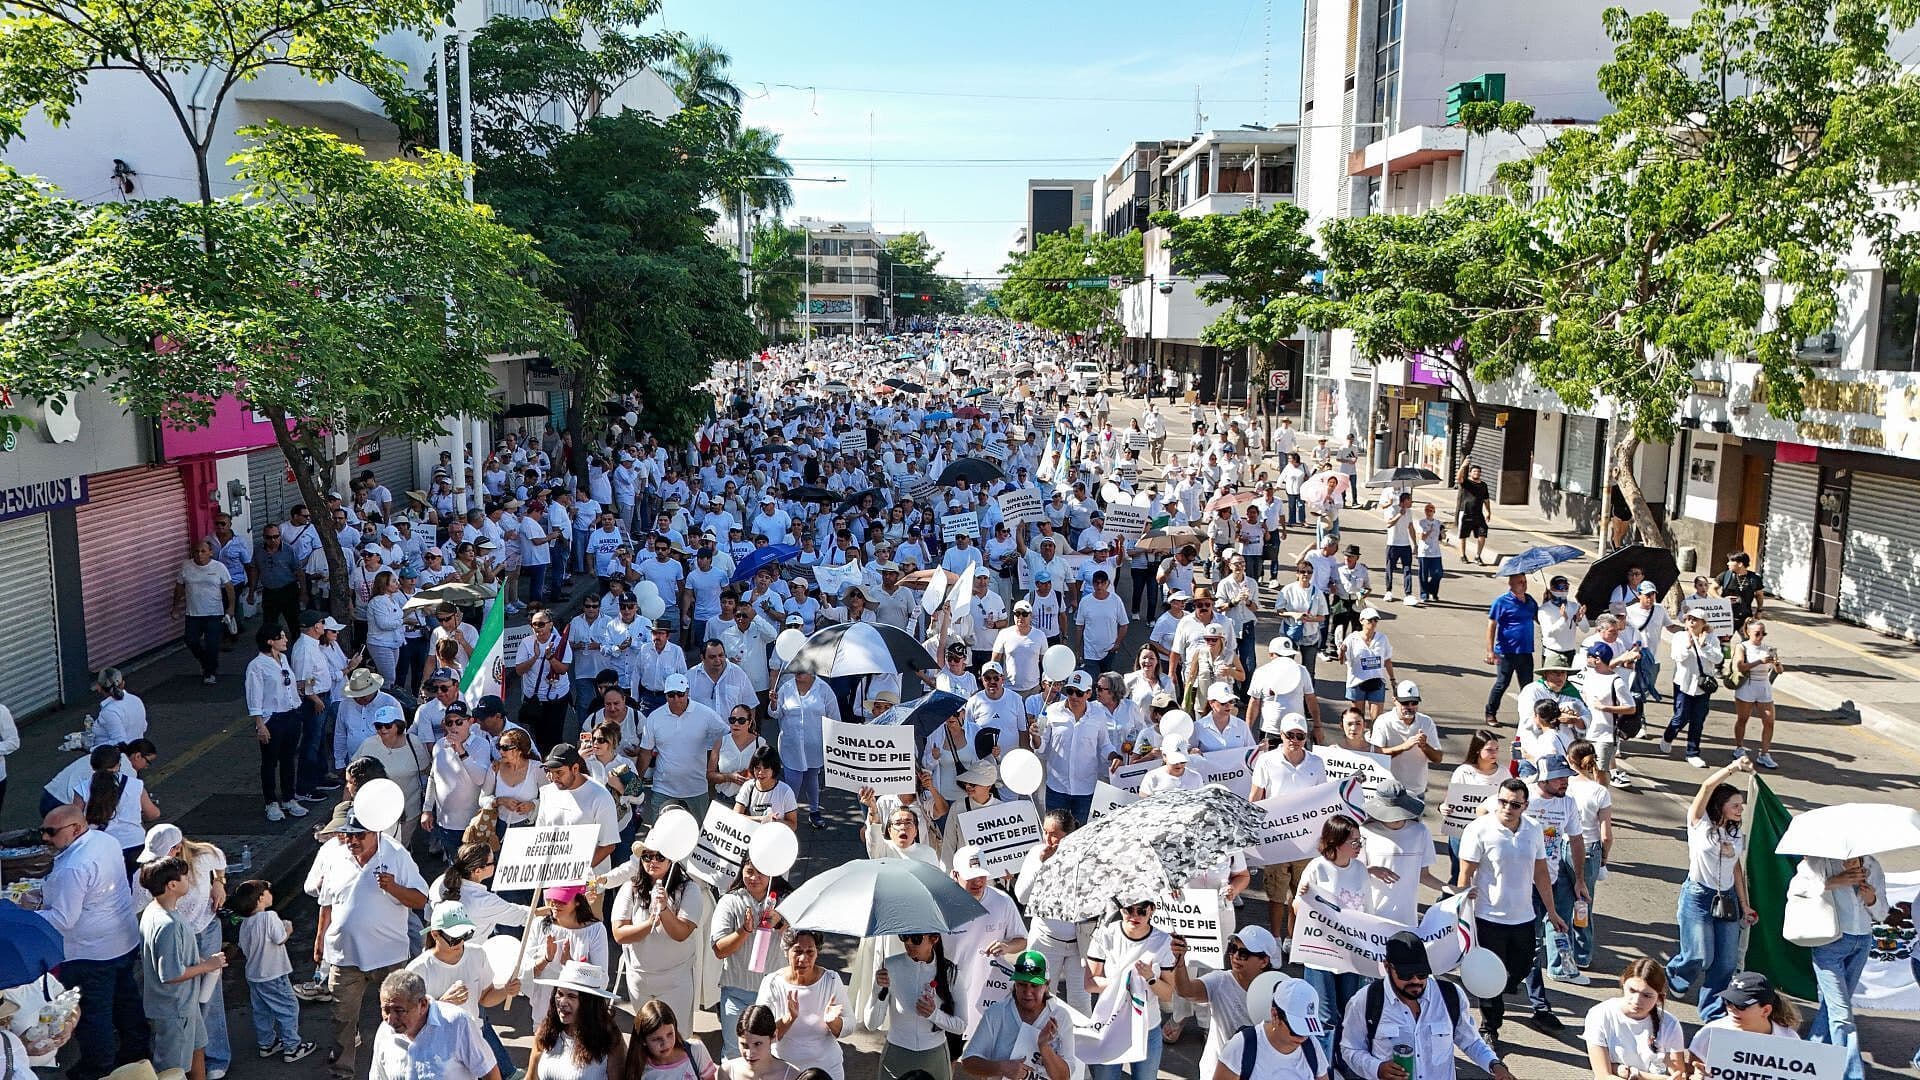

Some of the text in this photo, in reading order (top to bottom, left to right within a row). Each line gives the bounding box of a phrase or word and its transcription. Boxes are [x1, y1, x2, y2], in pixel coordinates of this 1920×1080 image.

[358, 440, 380, 457] HUELGA
[1001, 502, 1021, 513] PONTE
[1006, 494, 1034, 505] SINALOA
[948, 517, 971, 525] SINALOA
[1113, 510, 1140, 518] SINALOA
[837, 735, 896, 749] SINALOA
[825, 745, 911, 762] PONTE DE PIE
[1327, 758, 1375, 772] SINALOA
[826, 767, 839, 775] NO
[839, 770, 856, 781] MÁS
[856, 775, 869, 783] DE
[883, 775, 913, 783] MISMO
[1207, 769, 1244, 783] MIEDO
[1260, 803, 1343, 830] CALLES NO SON
[1448, 804, 1477, 814] PONT
[977, 814, 1024, 832] SINALOA
[535, 830, 570, 846] ¡SINALOA
[700, 829, 733, 852] PONTE
[715, 820, 751, 845] SINALO
[968, 824, 1038, 846] PONTE DE PIE
[1264, 827, 1312, 844] BATALLA.
[525, 844, 573, 857] REFLEXIONA!
[986, 851, 1022, 866] MÁS DE LO
[519, 863, 536, 883] LOS
[536, 861, 572, 881] MISMOS
[691, 852, 737, 878] NO MÁS DE LO
[1156, 901, 1201, 915] SINALOA
[1153, 915, 1217, 930] ONTE DE PIE
[1308, 910, 1367, 941] CULIACÁN
[1193, 945, 1220, 953] MISMO
[1303, 926, 1323, 938] NO
[1326, 934, 1387, 963] SOBREVIV
[986, 979, 1008, 990] NOS
[1732, 1050, 1817, 1076] SINALOA
